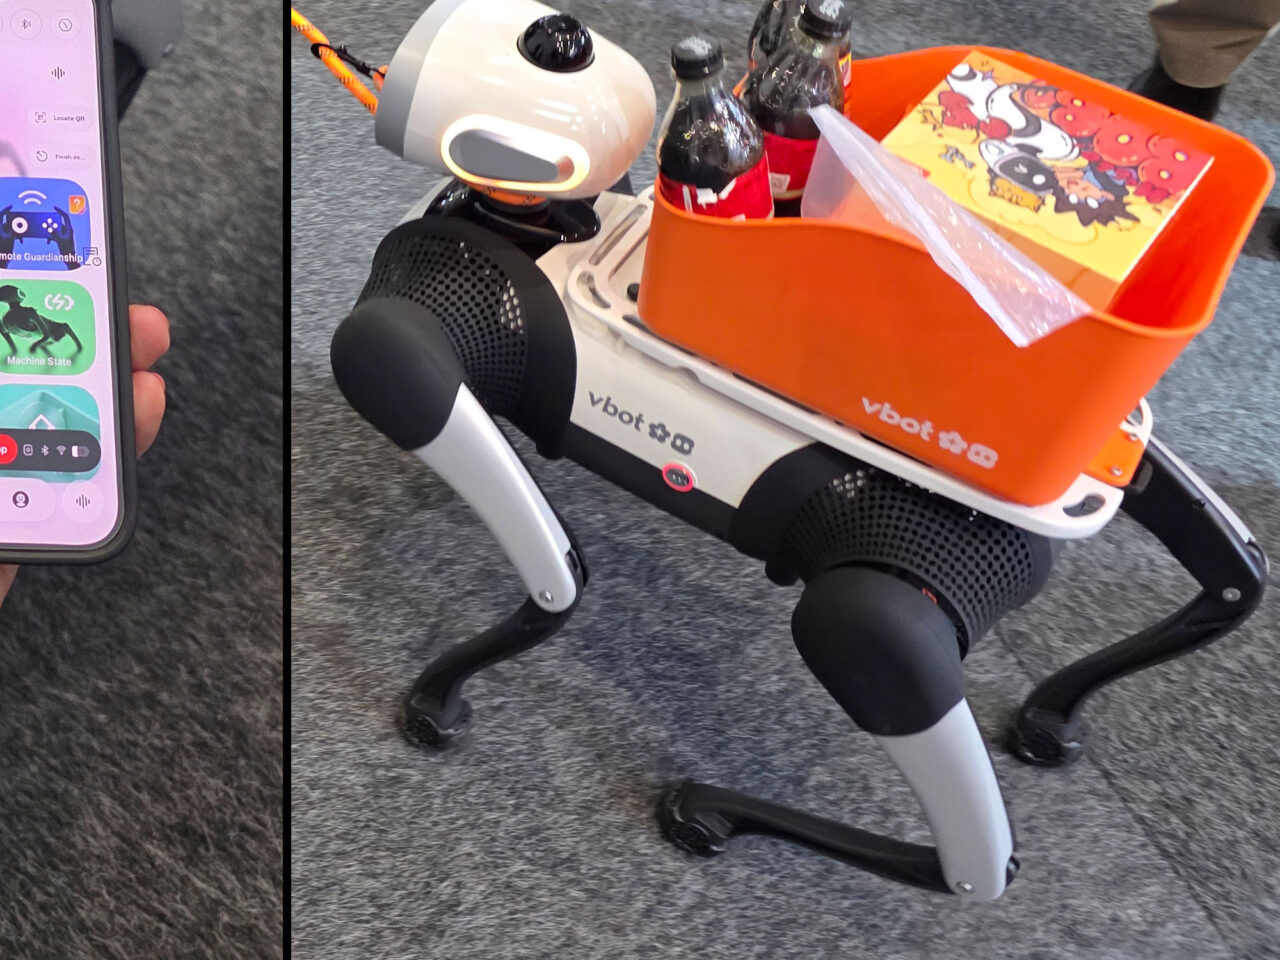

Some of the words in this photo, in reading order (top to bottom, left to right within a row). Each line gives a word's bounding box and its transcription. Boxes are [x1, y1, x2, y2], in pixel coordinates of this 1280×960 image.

[24, 252, 83, 264] Guardianship
[7, 356, 45, 366] Machine
[47, 356, 72, 367] State
[588, 390, 645, 432] vbot
[862, 396, 934, 442] vbot
